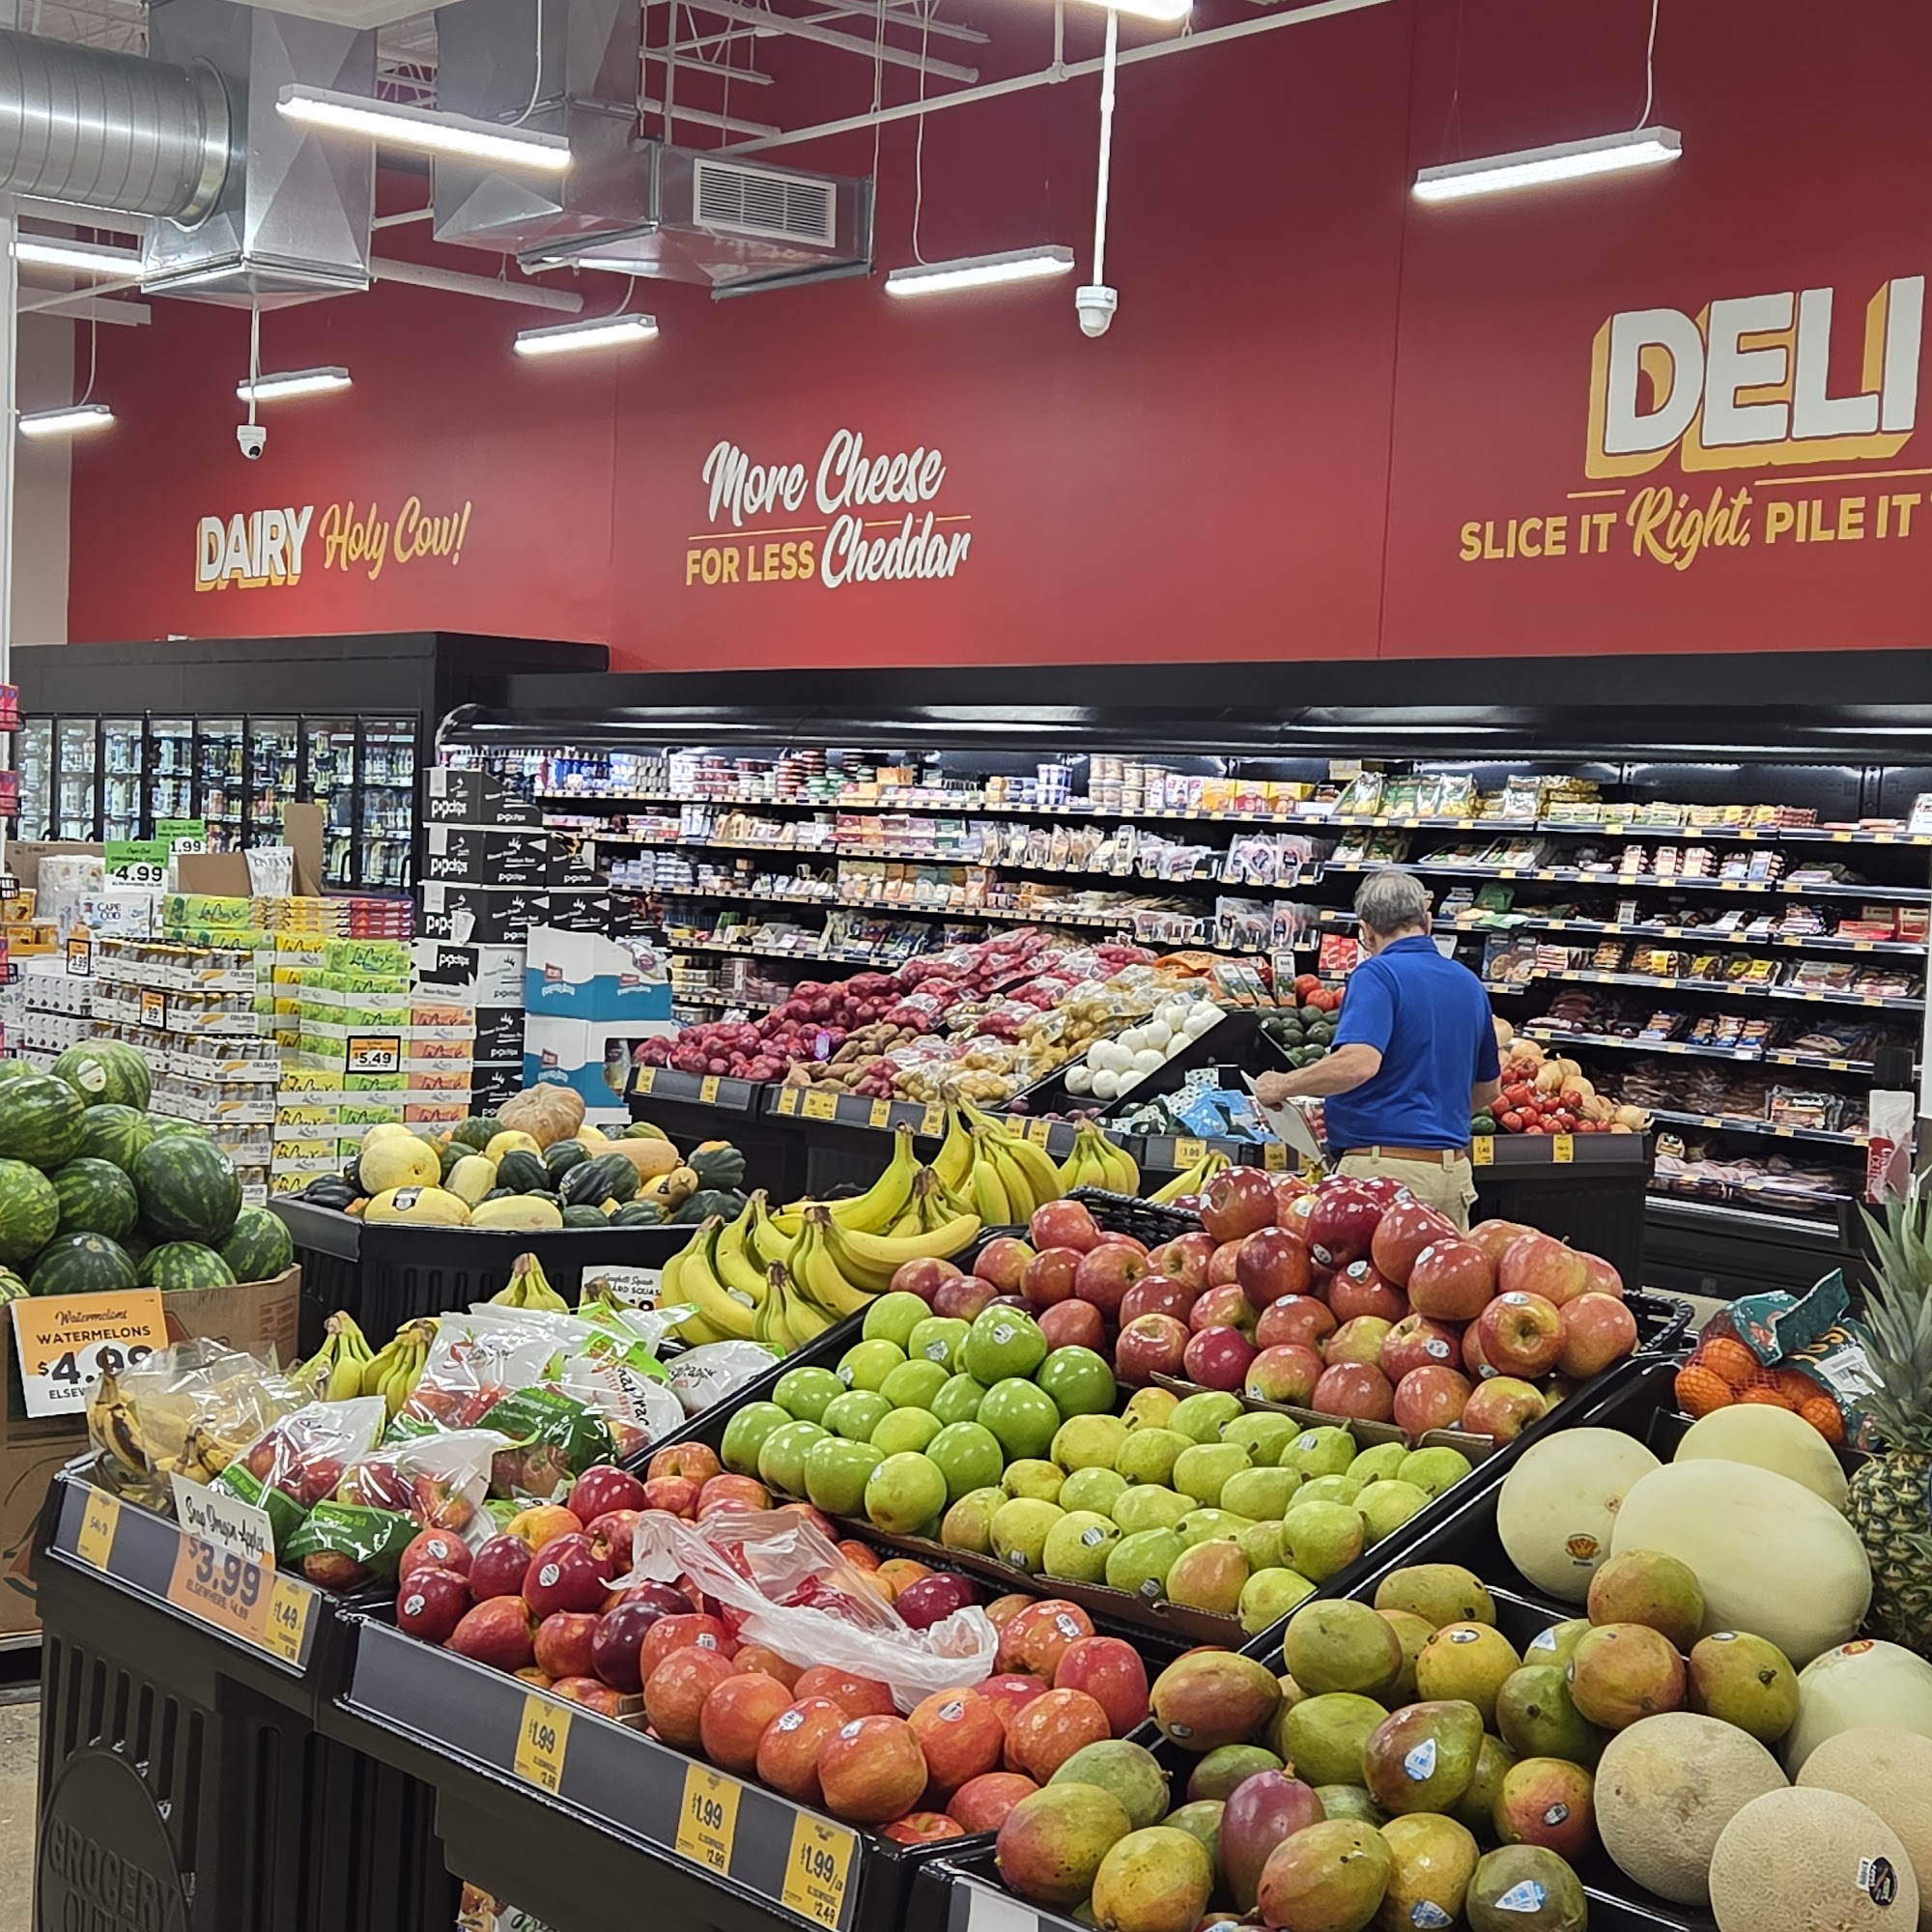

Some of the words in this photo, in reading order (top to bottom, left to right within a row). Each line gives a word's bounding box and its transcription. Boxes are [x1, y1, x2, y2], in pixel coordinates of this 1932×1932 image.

[1586, 275, 1925, 478] DELI
[702, 440, 808, 526] More
[816, 429, 947, 514] Cheese
[196, 506, 314, 591] DAIRY
[320, 500, 386, 580] Holy
[393, 497, 472, 565] Cow!
[686, 549, 740, 586] FOR
[748, 542, 815, 583] LESS
[821, 514, 971, 589] Cheddar
[1460, 515, 1567, 561] SLICE
[1579, 513, 1617, 554] IT
[1766, 497, 1865, 543] PILE
[1876, 494, 1921, 538] IT
[36, 1325, 152, 1345] WATERMELONS
[55, 1308, 128, 1326] Watermelons
[187, 1535, 261, 1607] $3.99
[49, 1815, 181, 1932] GROCERY
